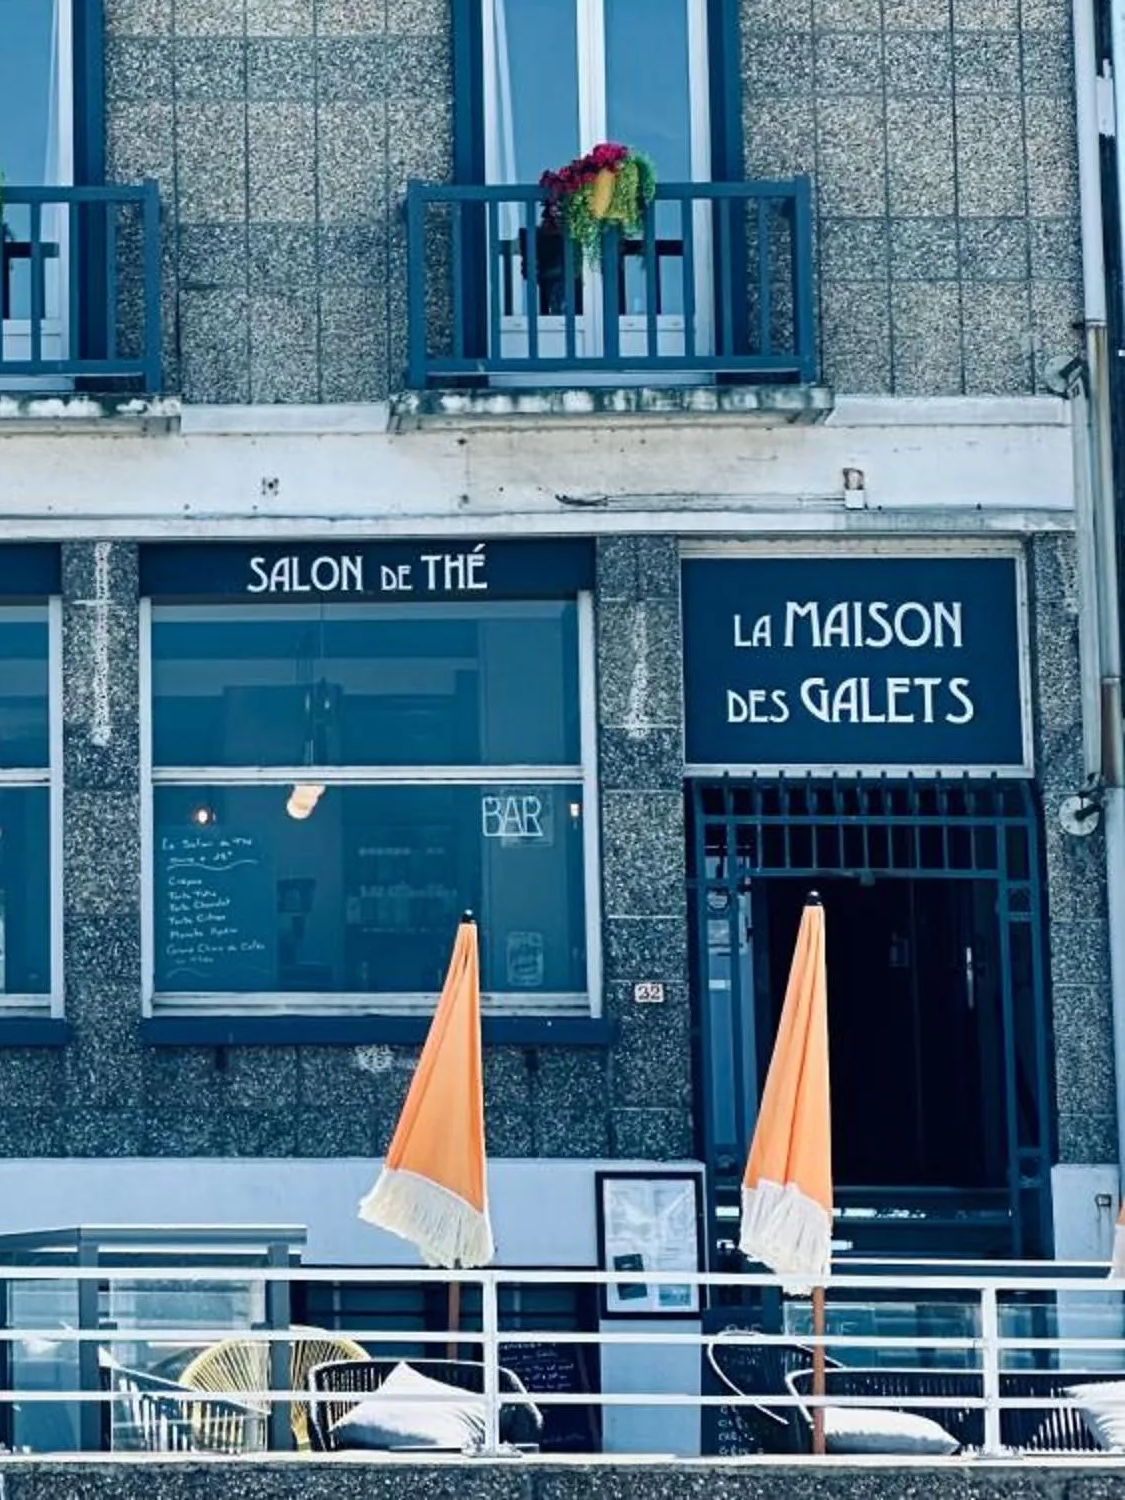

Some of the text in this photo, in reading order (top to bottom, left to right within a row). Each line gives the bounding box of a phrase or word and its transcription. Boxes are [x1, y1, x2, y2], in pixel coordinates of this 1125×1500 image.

[247, 544, 488, 593] SALON DE THÉ
[734, 601, 963, 648] LA MAISON
[727, 677, 974, 724] DES GALETS
[482, 795, 543, 837] BAR
[638, 985, 660, 1000] 32
